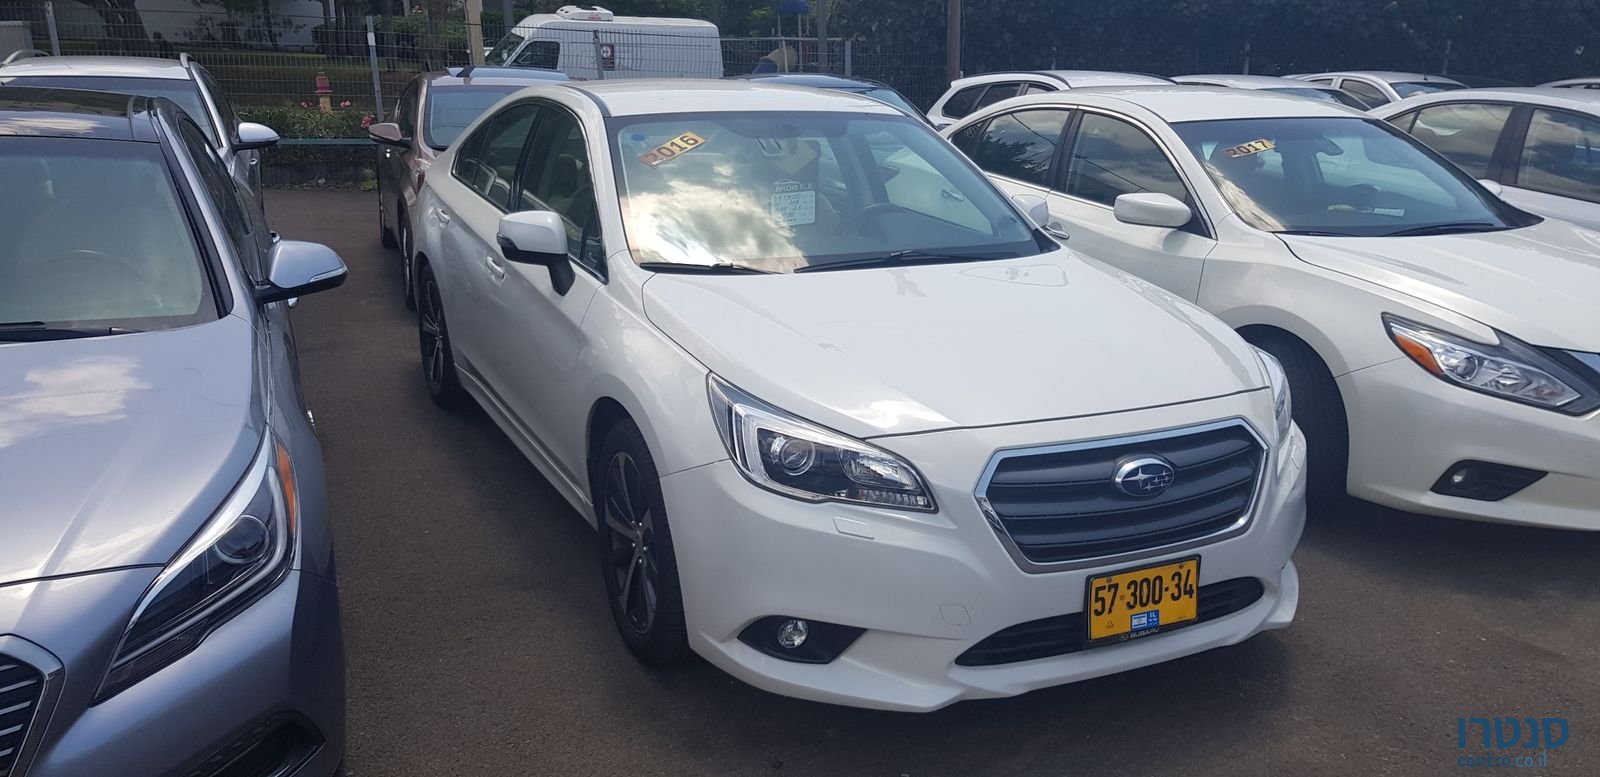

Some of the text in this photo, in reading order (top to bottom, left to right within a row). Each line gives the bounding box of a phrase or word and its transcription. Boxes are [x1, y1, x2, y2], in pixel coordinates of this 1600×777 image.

[645, 135, 699, 164] 2016
[1225, 140, 1268, 156] 2017
[1093, 569, 1194, 616] 57-300-34
